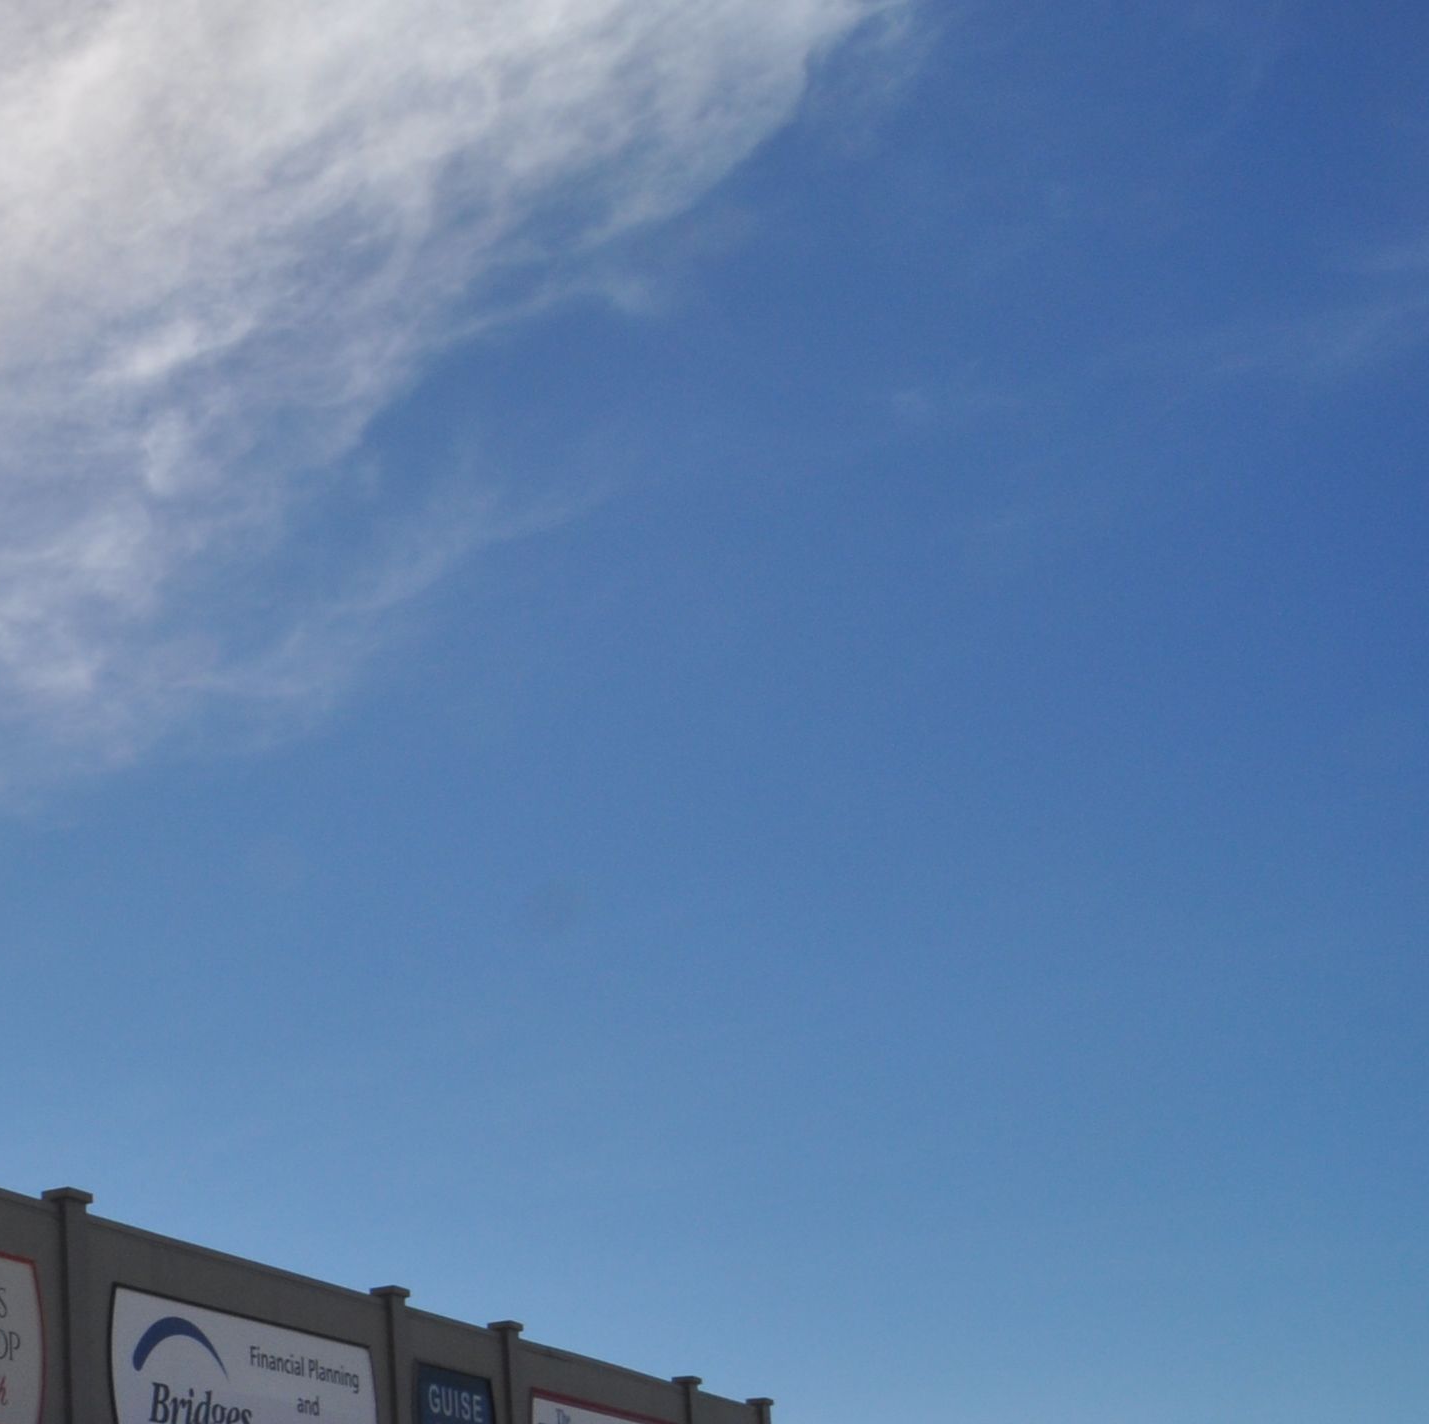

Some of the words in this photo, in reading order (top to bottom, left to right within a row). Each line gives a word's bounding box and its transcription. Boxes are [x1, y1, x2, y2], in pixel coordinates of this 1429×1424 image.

[250, 1346, 305, 1376] Financial
[308, 1359, 359, 1393] Planning
[296, 1396, 320, 1416] and
[428, 1384, 483, 1423] GUISE
